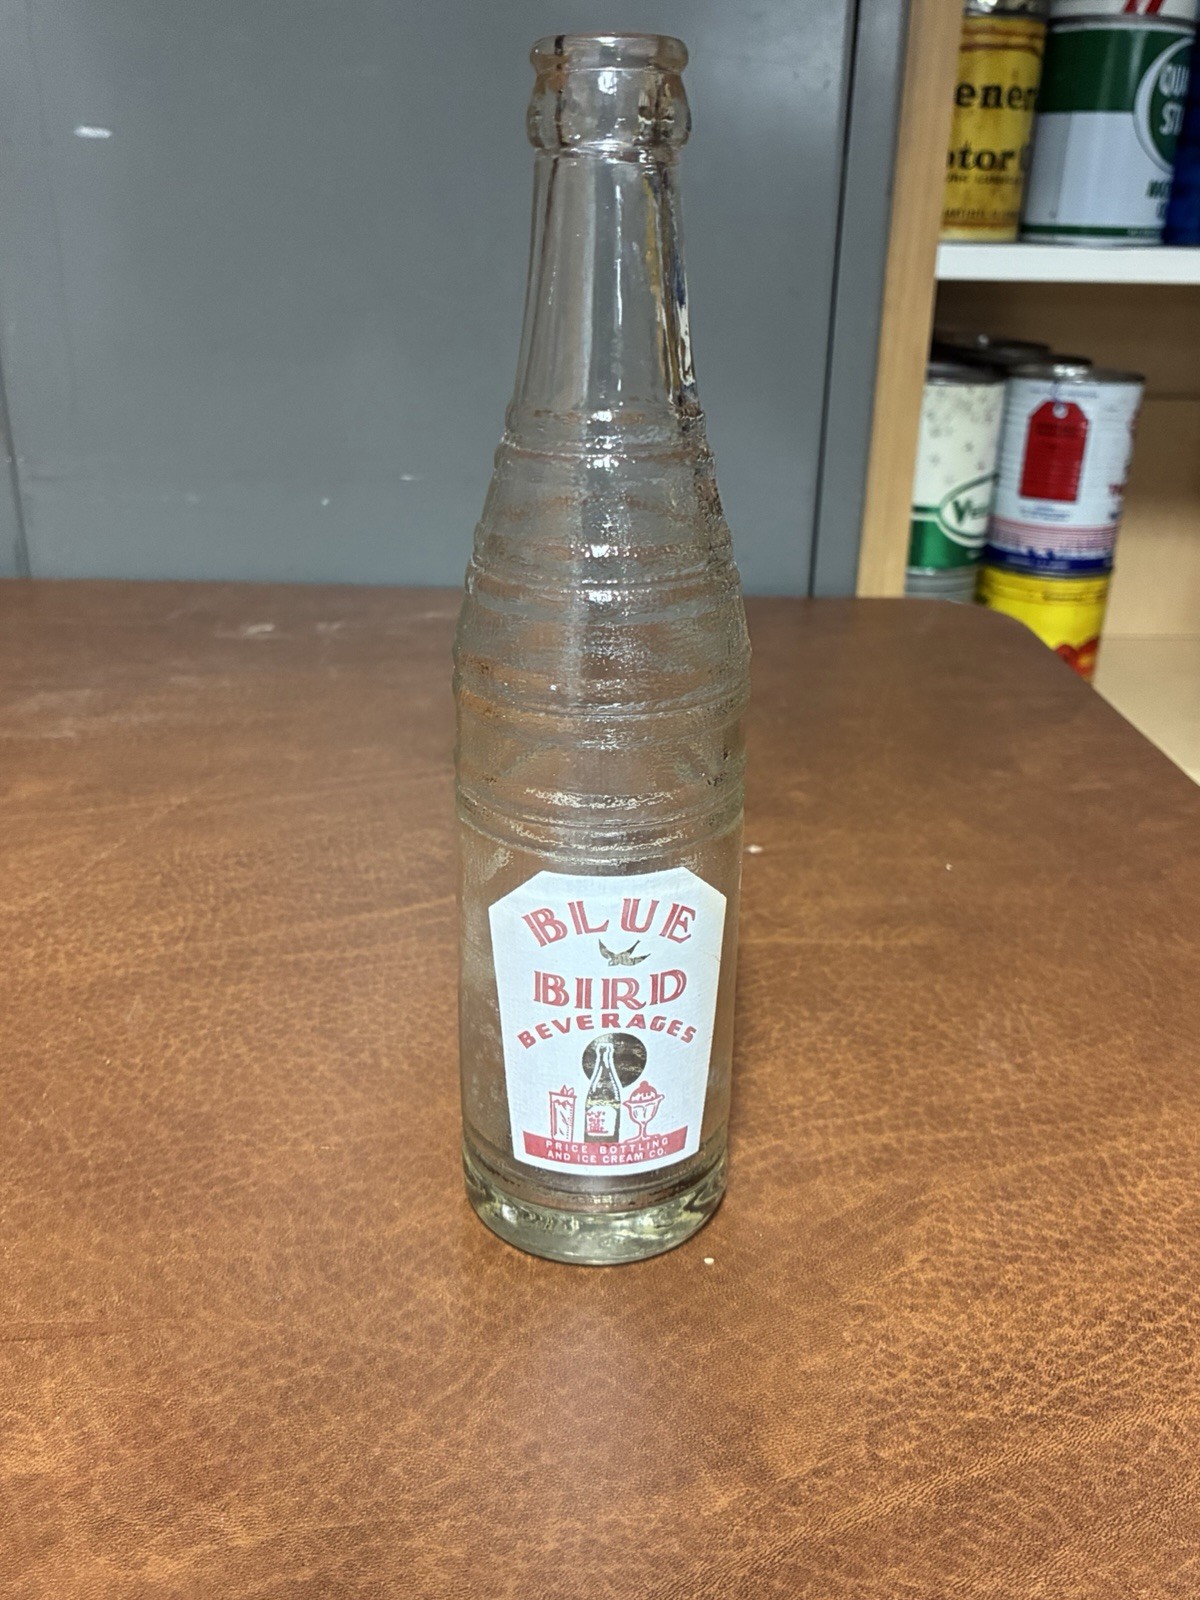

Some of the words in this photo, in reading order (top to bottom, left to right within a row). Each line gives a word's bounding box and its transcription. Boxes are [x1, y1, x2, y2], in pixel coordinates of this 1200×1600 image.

[522, 898, 696, 947] BLUE
[533, 968, 687, 1011] BIRD
[517, 1012, 697, 1050] BEVERAGES
[545, 1139, 588, 1154] PRICE
[599, 1136, 669, 1155] BOTTLING
[547, 1150, 571, 1162] AND
[577, 1154, 597, 1164] ICE
[602, 1151, 644, 1165] CREAM
